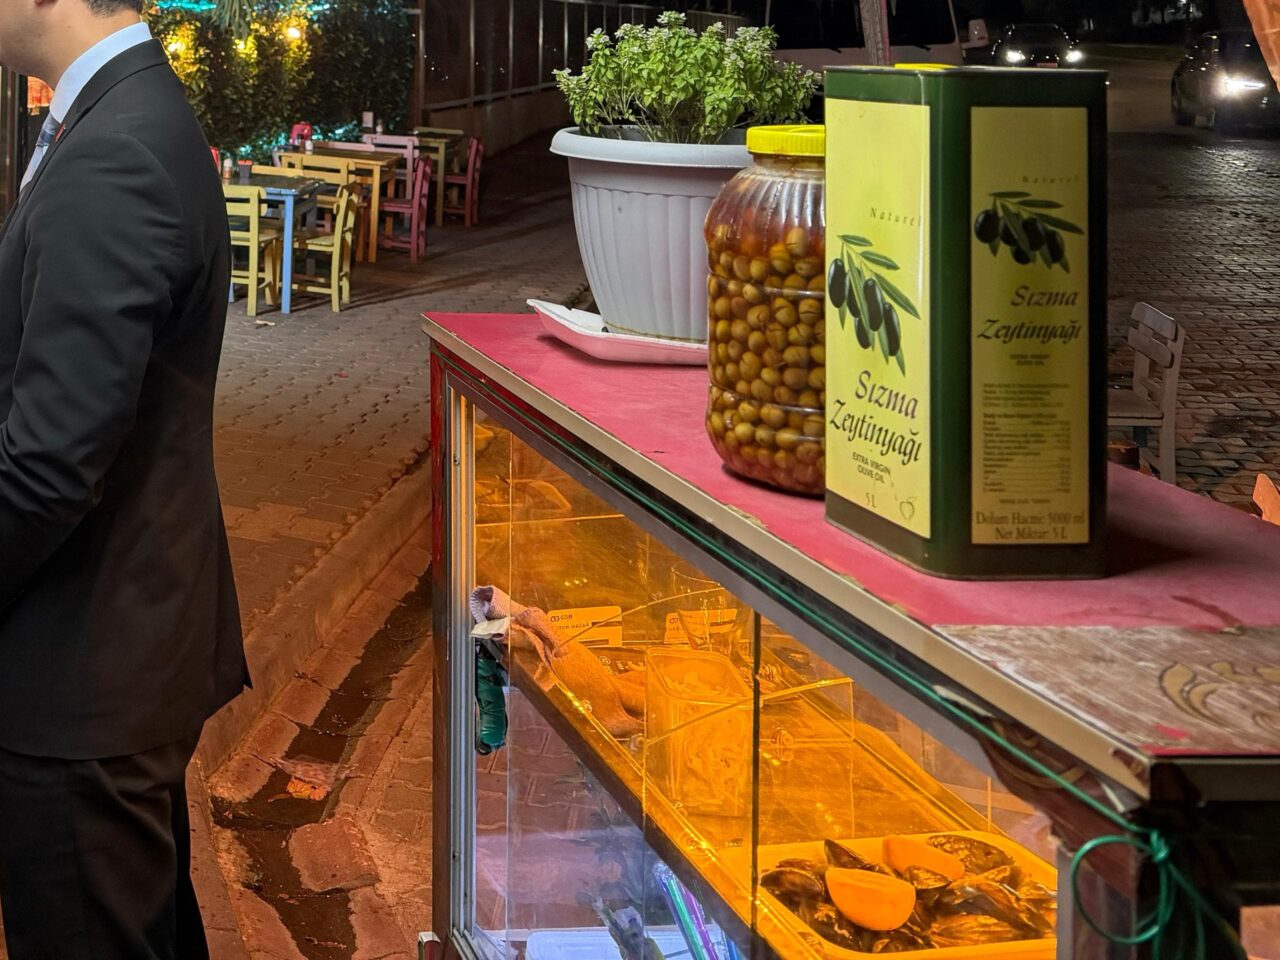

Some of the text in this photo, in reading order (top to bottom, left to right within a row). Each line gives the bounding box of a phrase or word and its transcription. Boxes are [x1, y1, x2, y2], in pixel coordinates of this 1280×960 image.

[1011, 285, 1079, 307] Sızma
[977, 319, 1082, 344] Zeytinyağı
[855, 370, 919, 420] Sızma
[830, 399, 922, 466] Zeytinyağı
[852, 451, 870, 466] EXTRA
